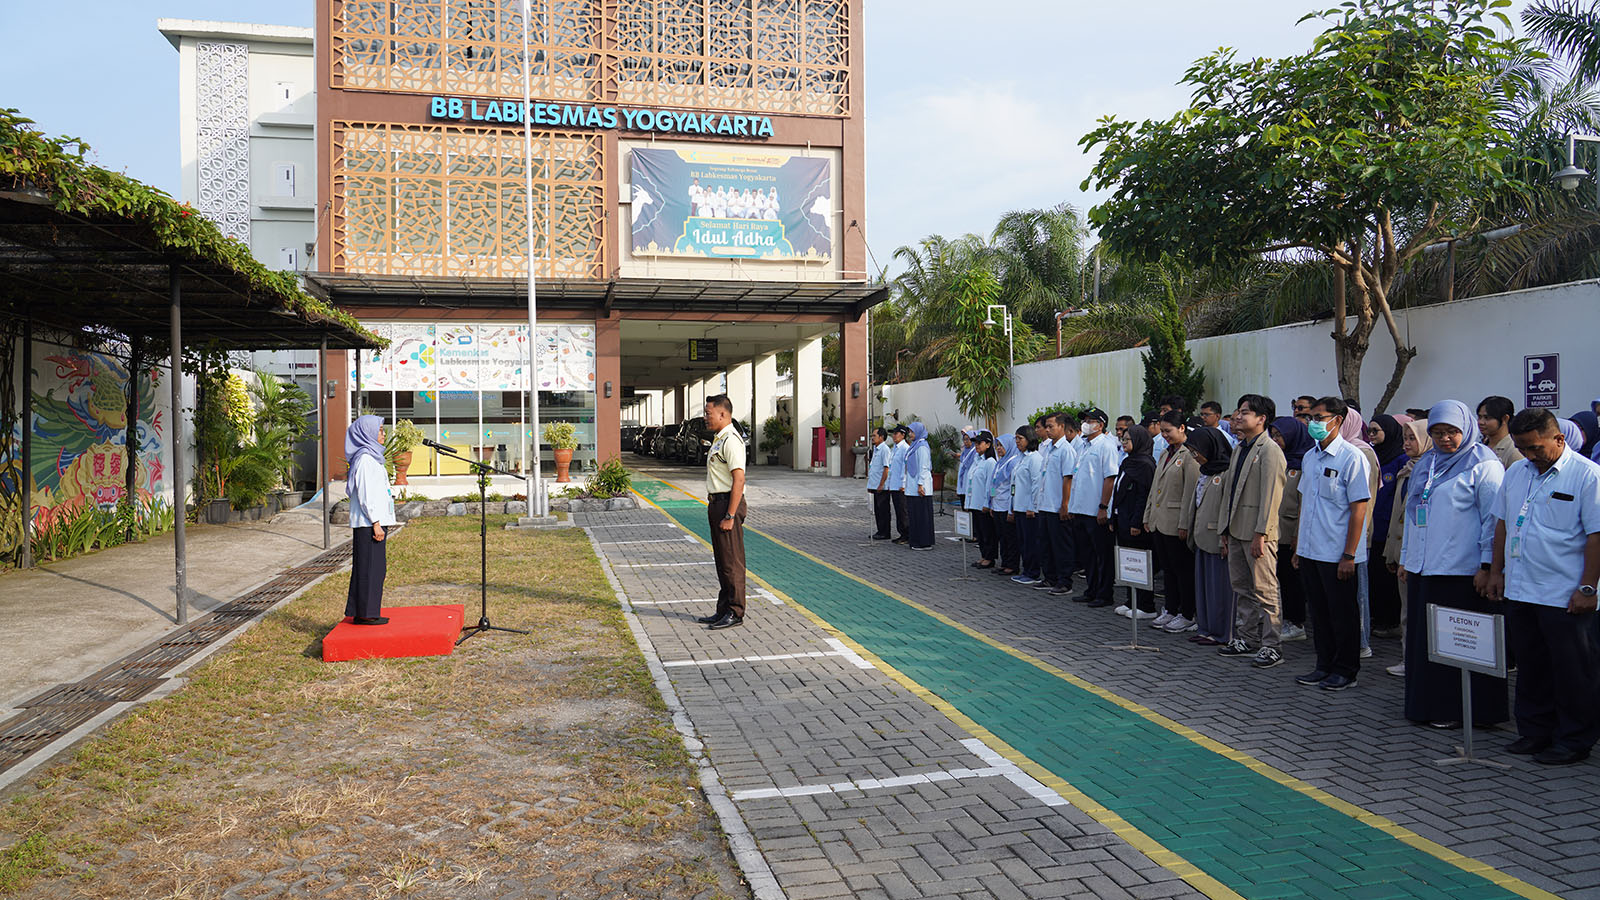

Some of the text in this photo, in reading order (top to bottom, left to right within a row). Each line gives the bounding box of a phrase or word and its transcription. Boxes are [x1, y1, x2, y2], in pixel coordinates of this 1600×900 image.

[431, 97, 774, 137] BB LABKESMAS YOGYAKARTA
[738, 174, 777, 182] Yogyakarta
[700, 221, 768, 231] Selamat Hari Raya
[693, 229, 776, 246] Idul Adha
[1528, 359, 1544, 382] P
[1449, 616, 1472, 625] PLETON
